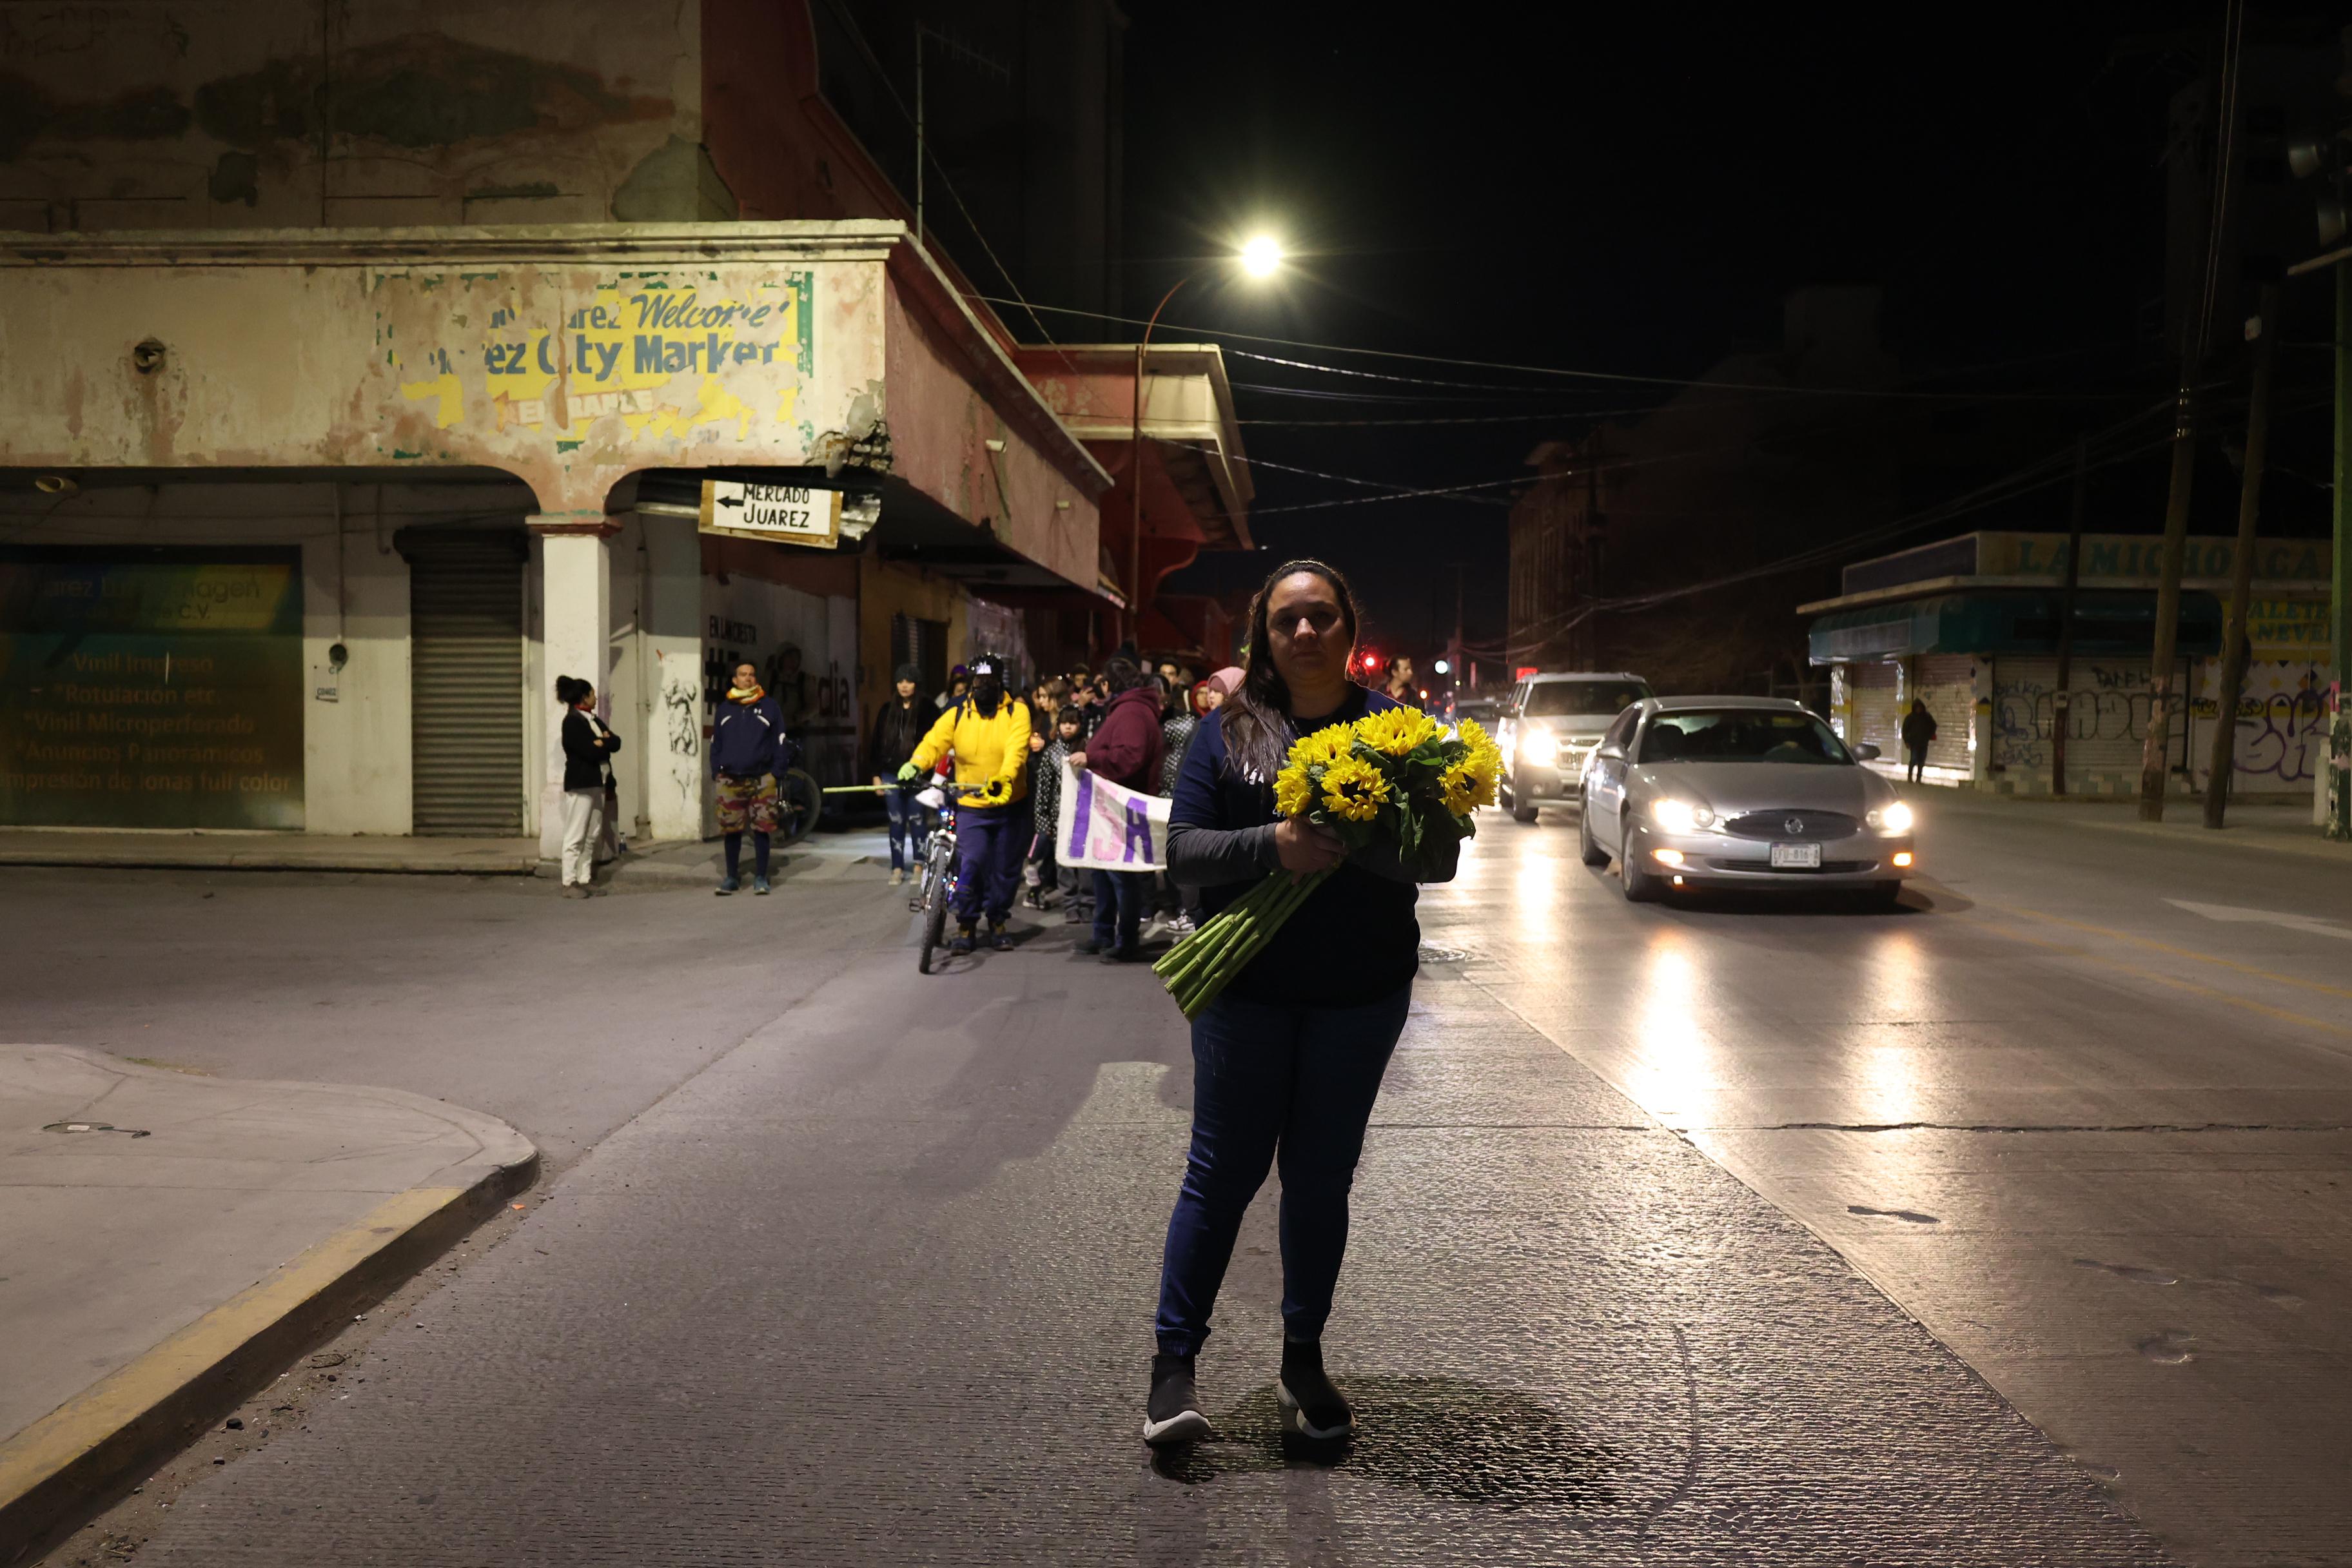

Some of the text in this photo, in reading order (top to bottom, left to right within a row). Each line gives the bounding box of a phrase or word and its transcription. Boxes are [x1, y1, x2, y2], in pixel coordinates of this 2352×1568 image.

[538, 333, 622, 382] Cty
[743, 483, 810, 504] MERCADO
[743, 503, 810, 528] JUAREZ
[74, 652, 121, 672] Vinil
